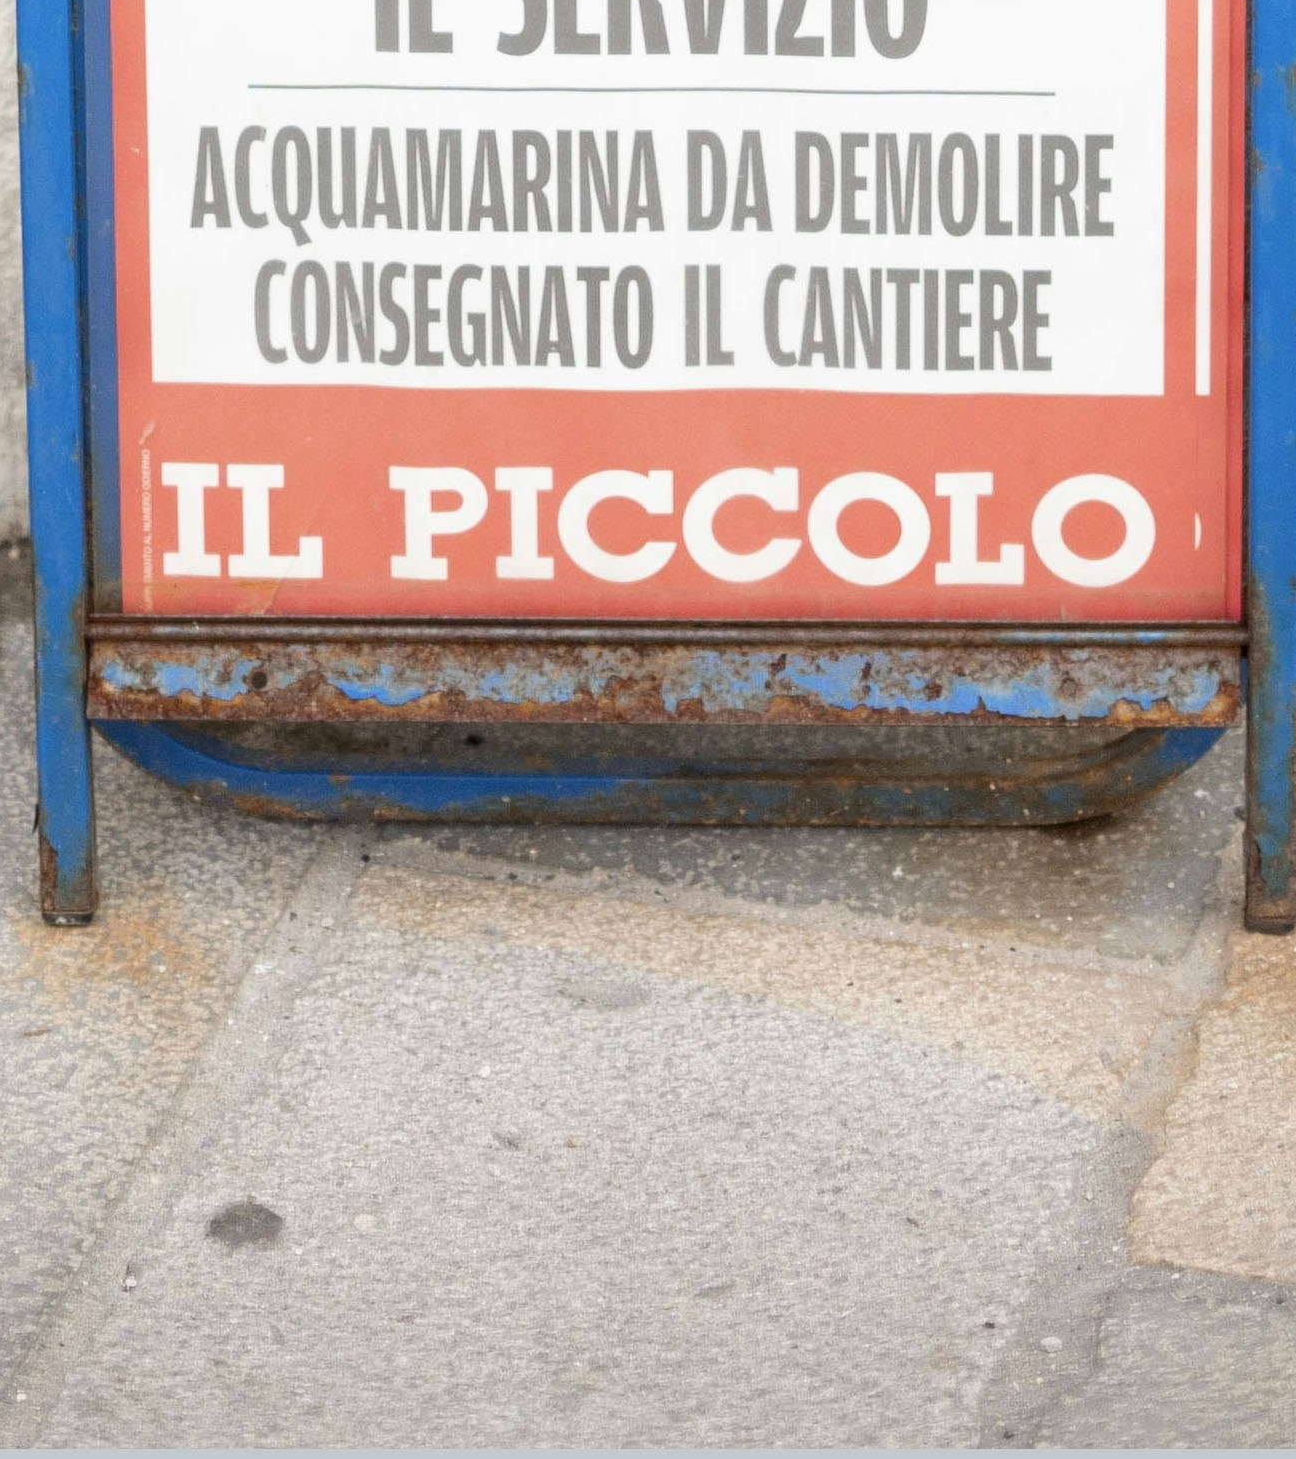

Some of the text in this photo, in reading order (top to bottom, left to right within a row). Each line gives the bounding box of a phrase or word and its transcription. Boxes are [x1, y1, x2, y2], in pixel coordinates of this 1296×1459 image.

[191, 125, 1115, 248] ACQUAMARINA DA DEMOLIRE
[254, 259, 1053, 373] CONSEGNATO IL CANTIERE
[160, 463, 323, 582] IL
[388, 466, 1157, 588] PICCOLO
